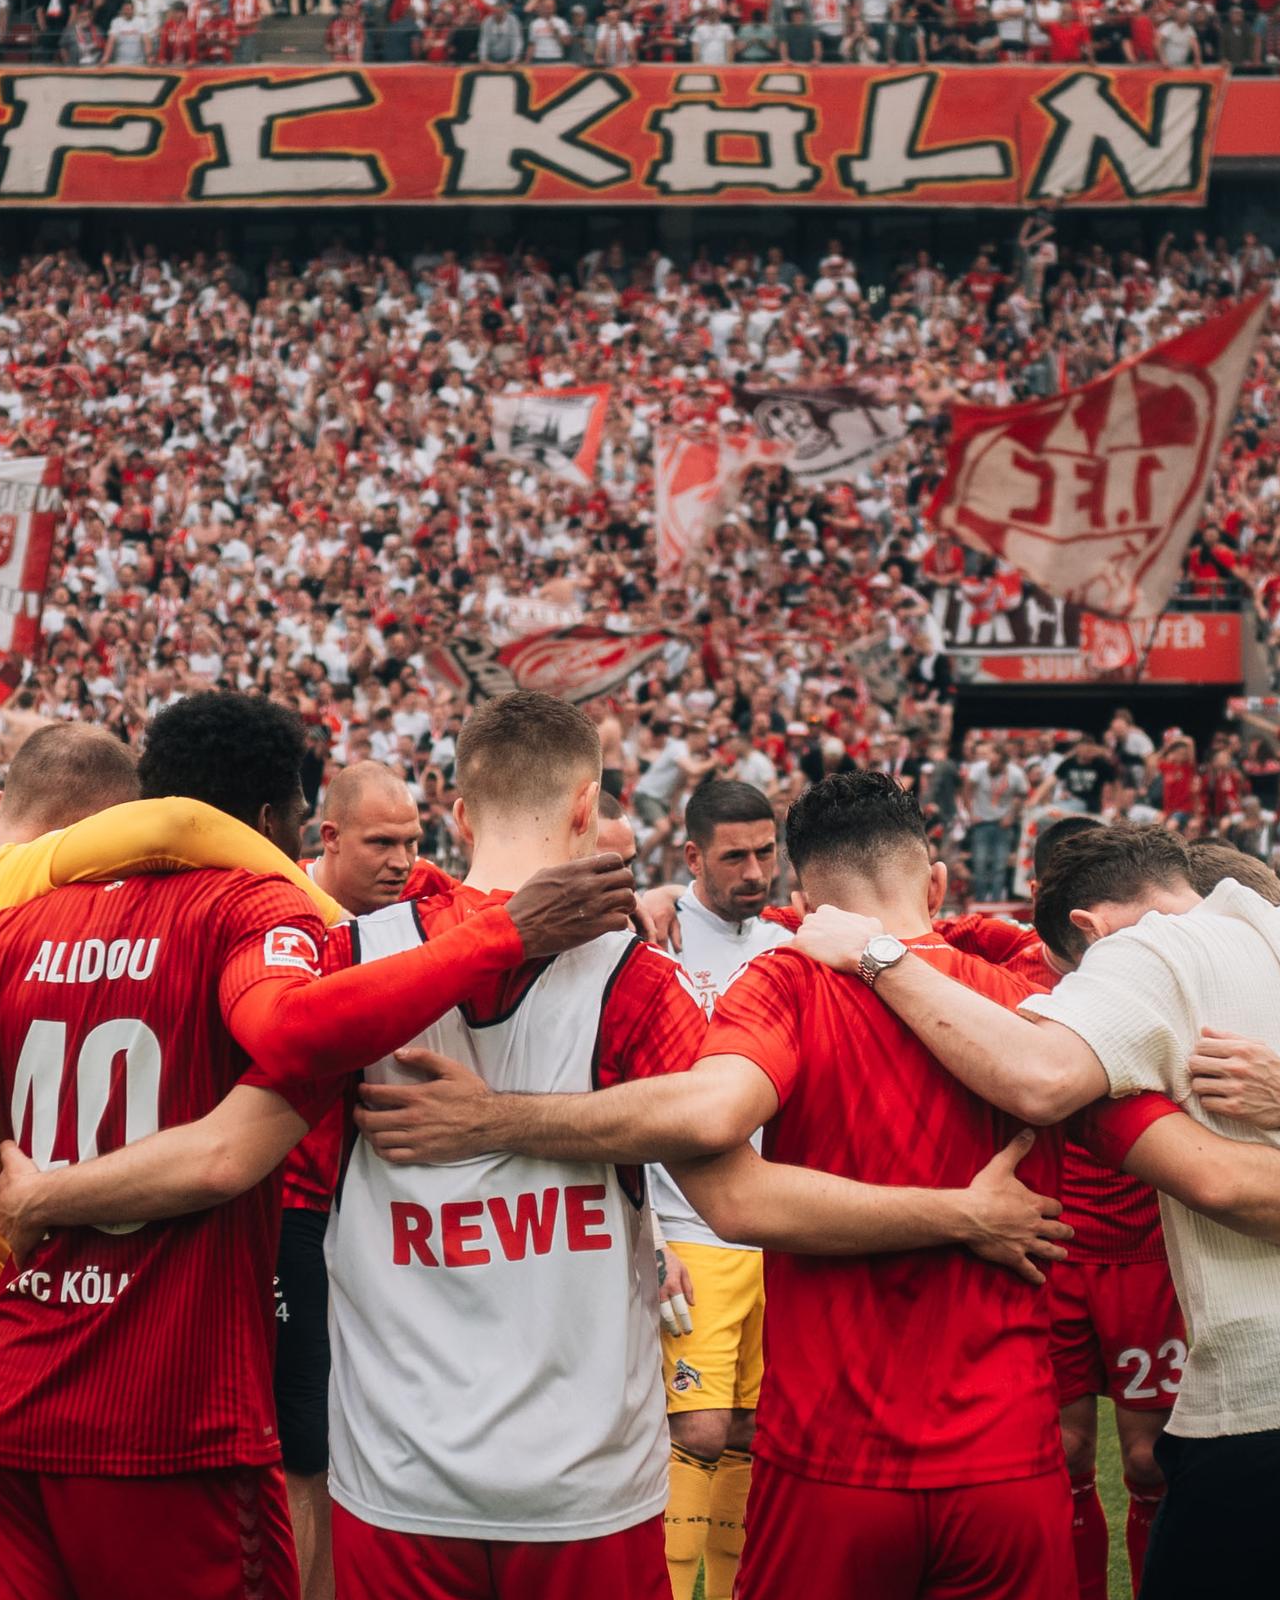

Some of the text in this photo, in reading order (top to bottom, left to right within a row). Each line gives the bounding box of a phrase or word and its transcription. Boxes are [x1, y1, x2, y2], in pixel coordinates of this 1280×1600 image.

[436, 69, 1216, 199] KÖLN
[23, 936, 161, 985] ALIDOU
[391, 1183, 613, 1269] REWE
[1116, 1337, 1188, 1400] 23
